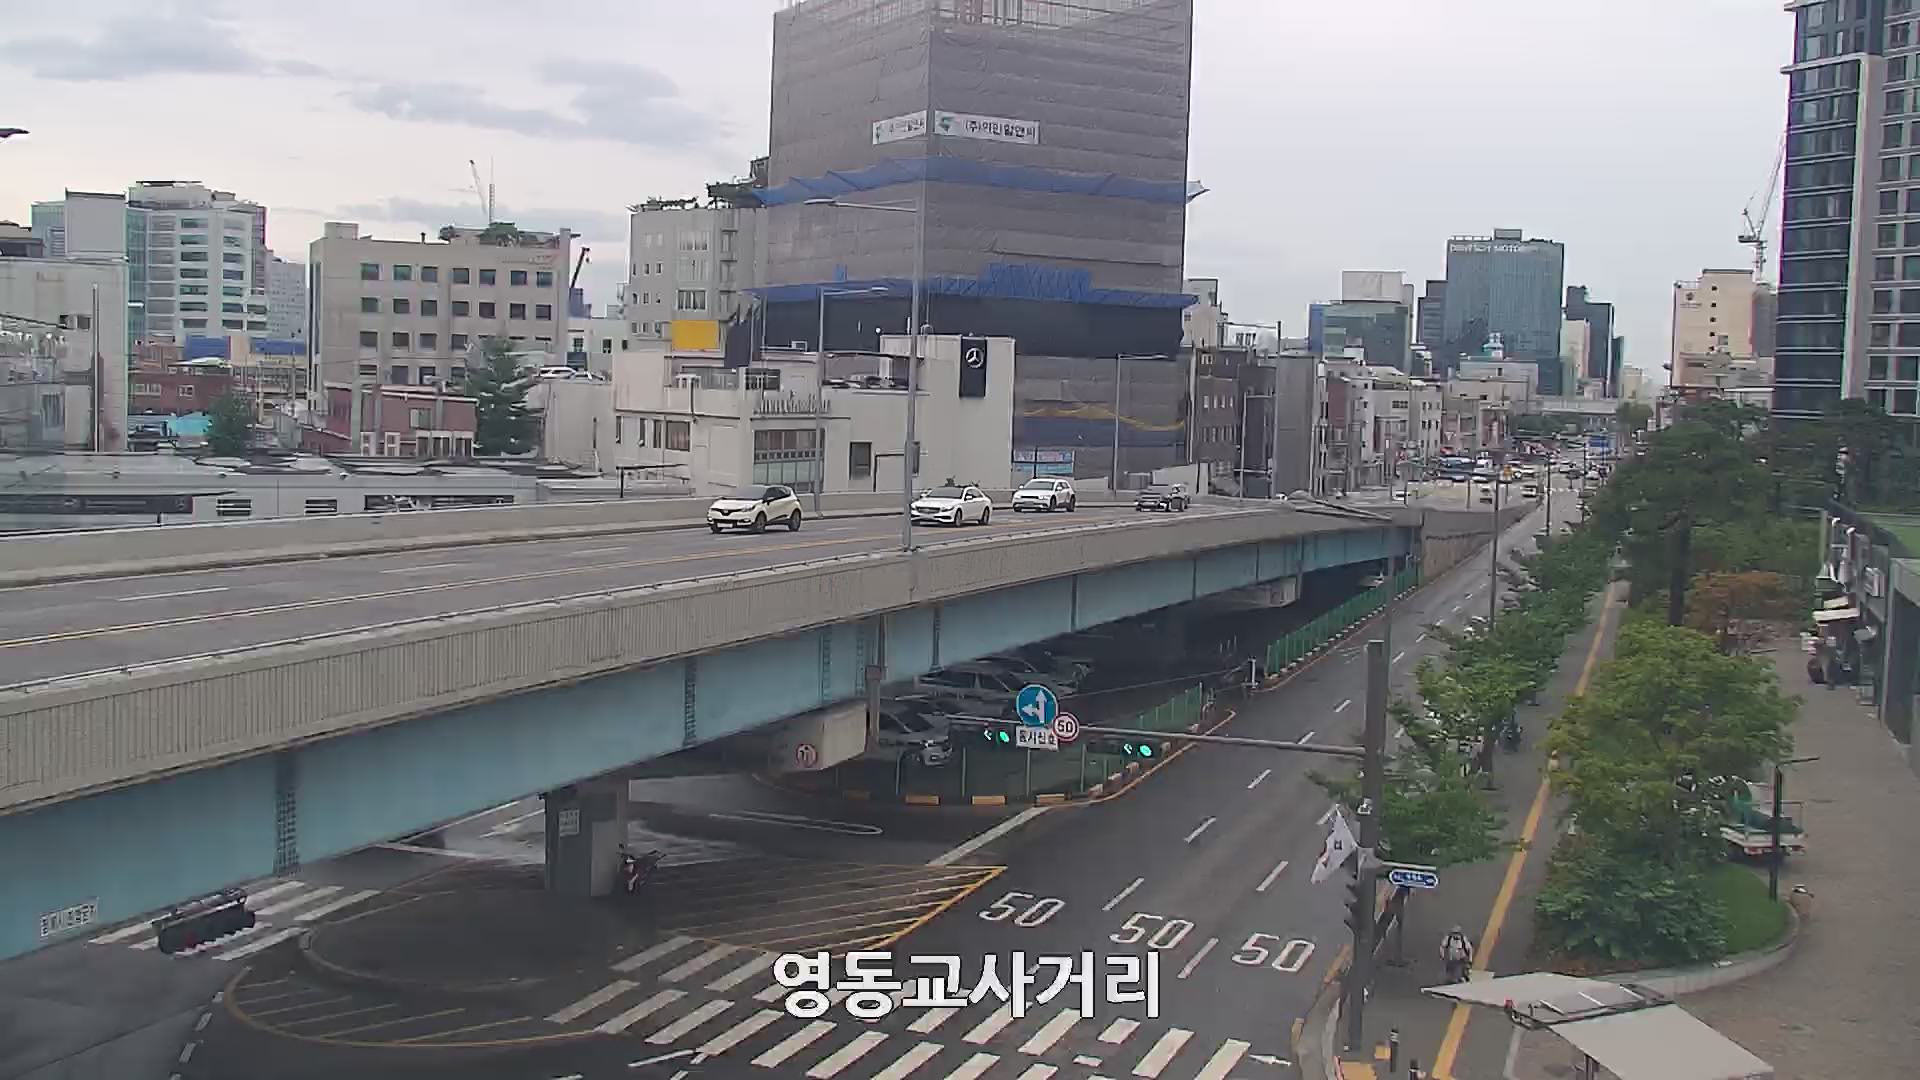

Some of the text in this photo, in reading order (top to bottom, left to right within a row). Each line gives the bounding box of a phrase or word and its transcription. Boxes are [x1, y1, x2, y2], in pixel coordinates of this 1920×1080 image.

[1058, 719, 1073, 733] 50
[978, 891, 1066, 928] 50
[1109, 911, 1195, 950] 50
[1231, 931, 1316, 974] 50
